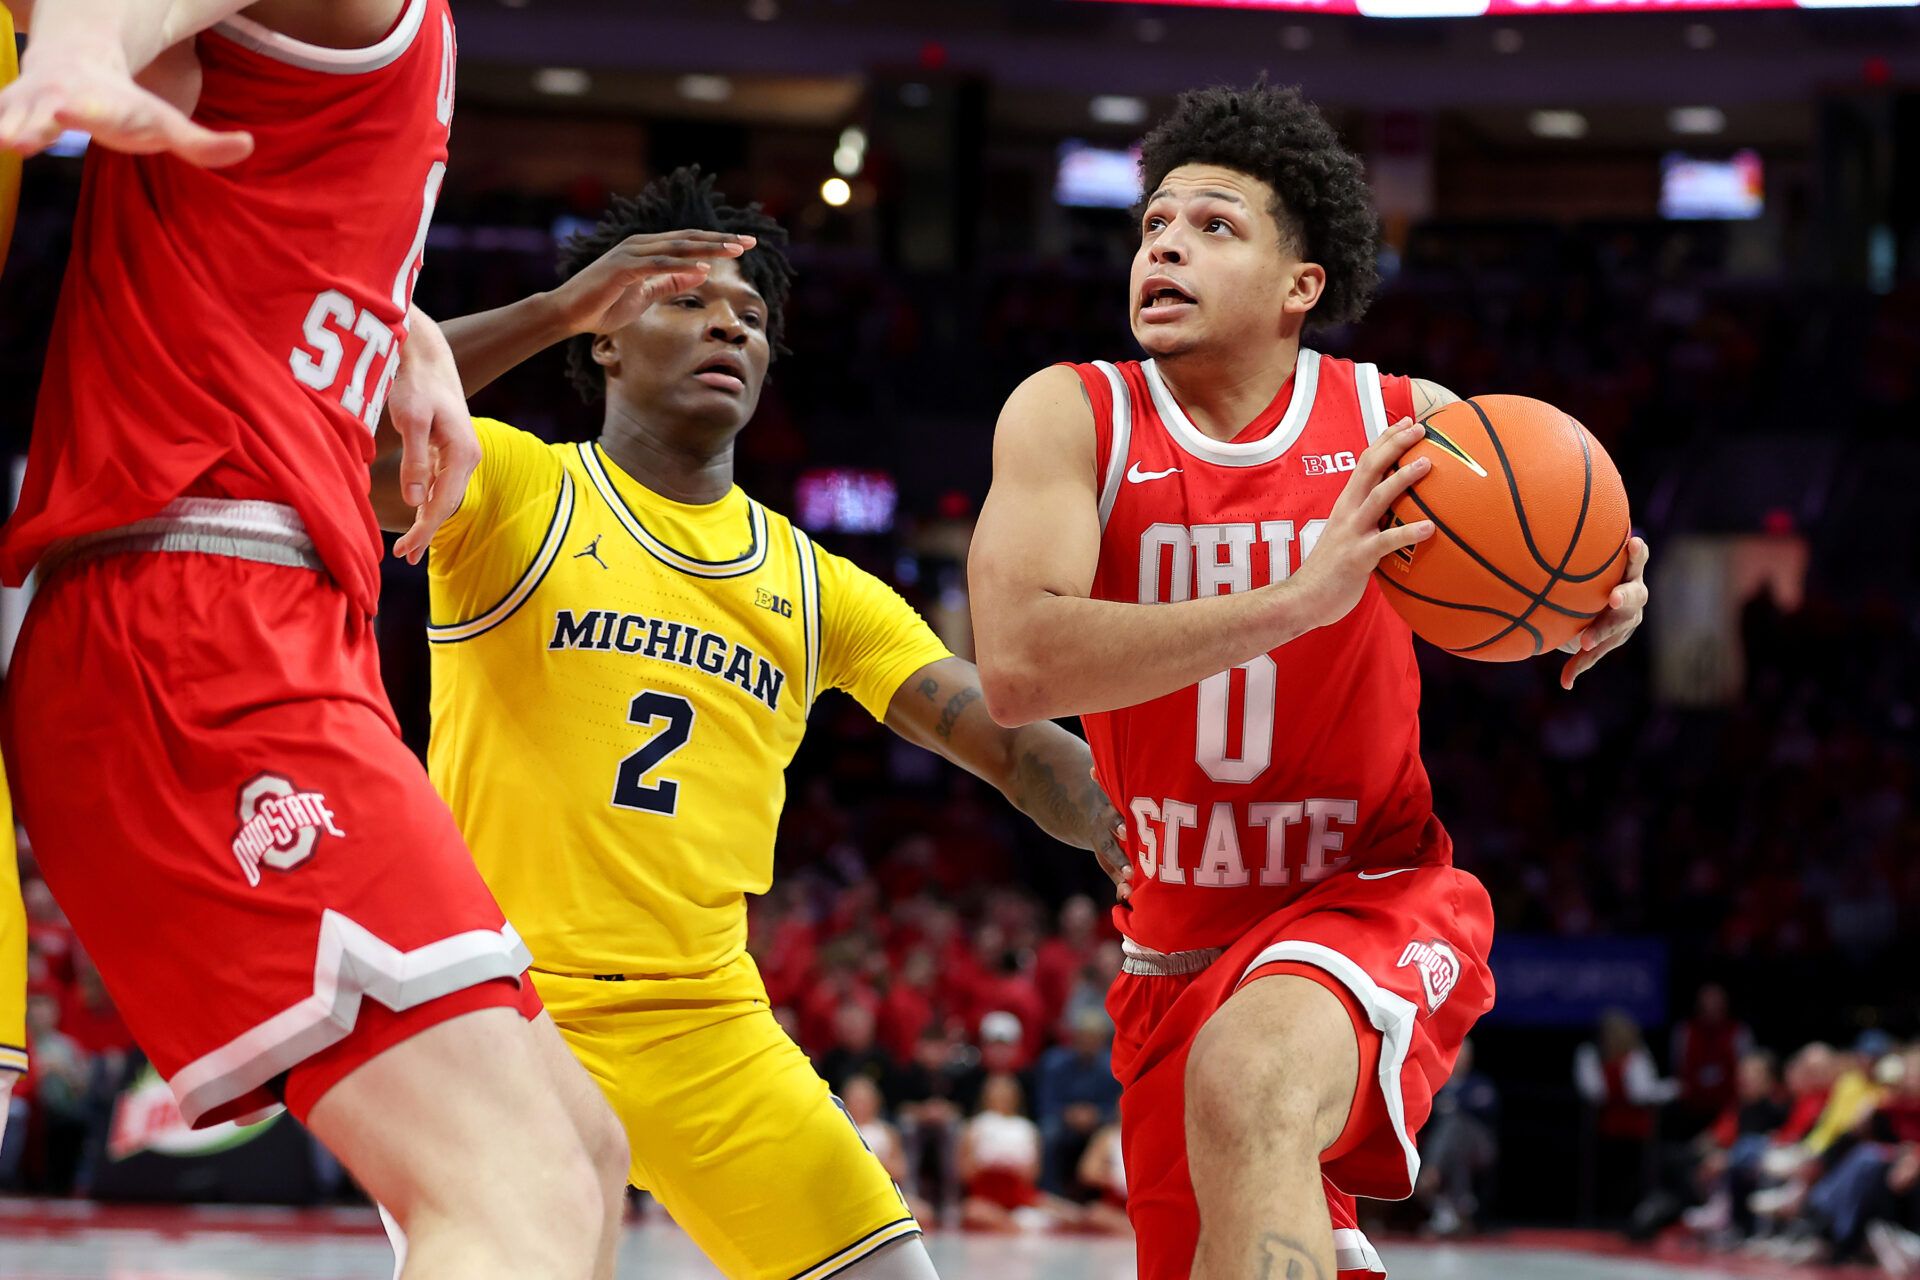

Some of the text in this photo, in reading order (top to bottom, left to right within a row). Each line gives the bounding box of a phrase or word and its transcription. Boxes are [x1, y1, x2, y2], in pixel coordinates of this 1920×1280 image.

[548, 610, 785, 711] MICHIGAN
[611, 689, 695, 815] 2
[1195, 652, 1277, 784] 0
[1130, 796, 1358, 887] STATE
